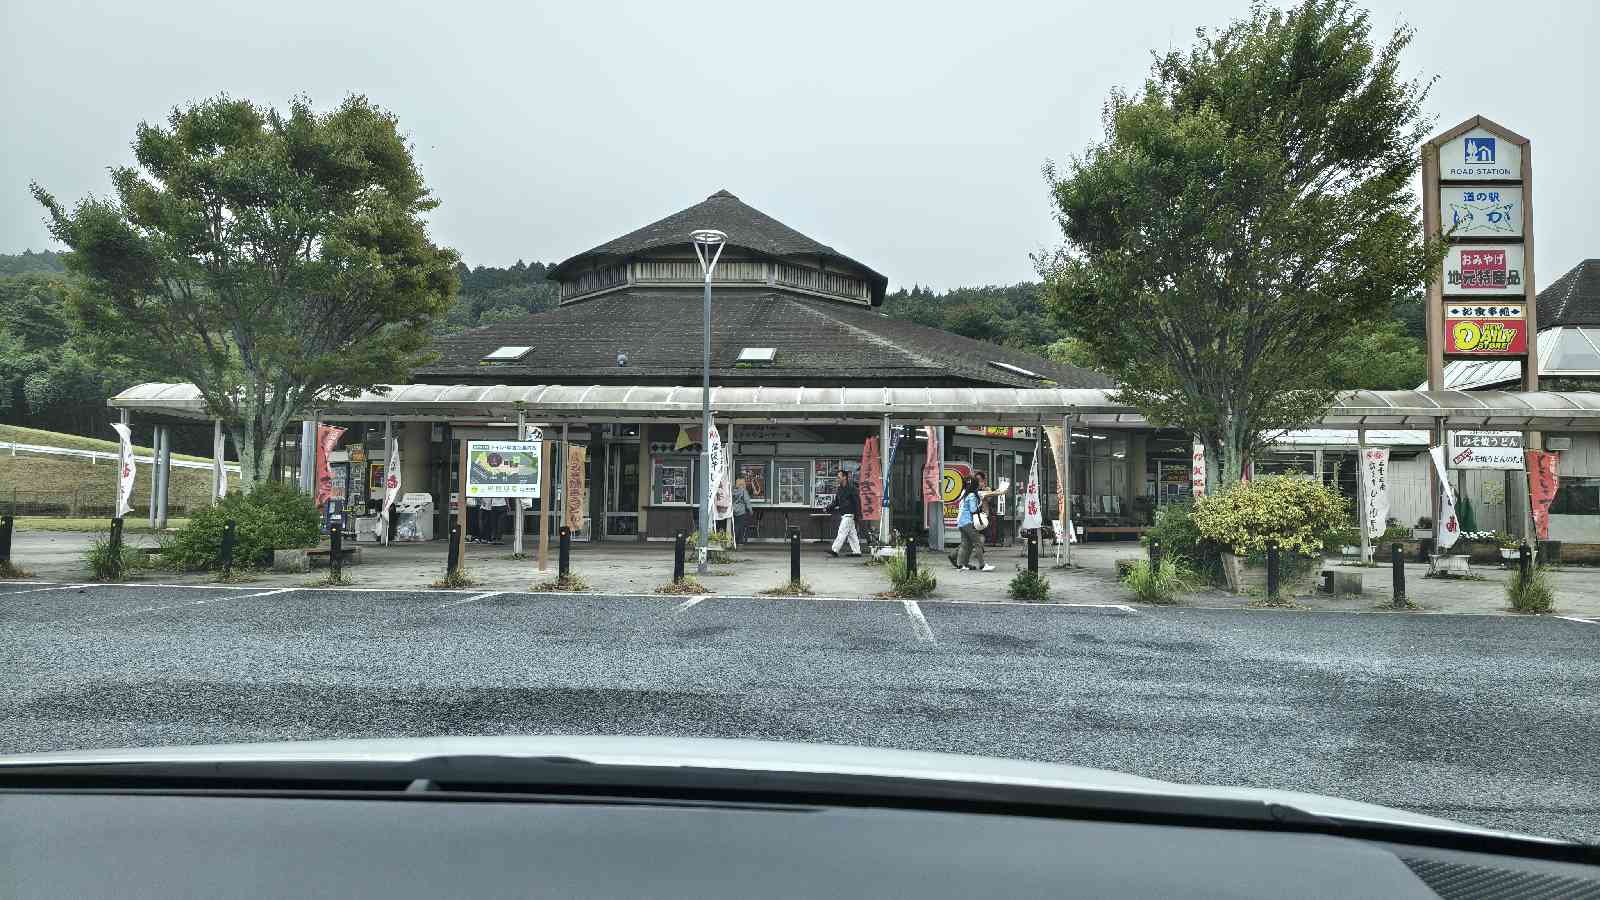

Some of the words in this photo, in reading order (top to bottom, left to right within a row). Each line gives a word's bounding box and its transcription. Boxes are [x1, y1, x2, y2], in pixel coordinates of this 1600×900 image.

[1463, 192, 1500, 202] 道の駅
[1462, 253, 1504, 266] おみやげ
[1447, 269, 1521, 286] 地元特産品
[1477, 342, 1509, 350] STORE
[1462, 436, 1518, 447] みそ焼うどん
